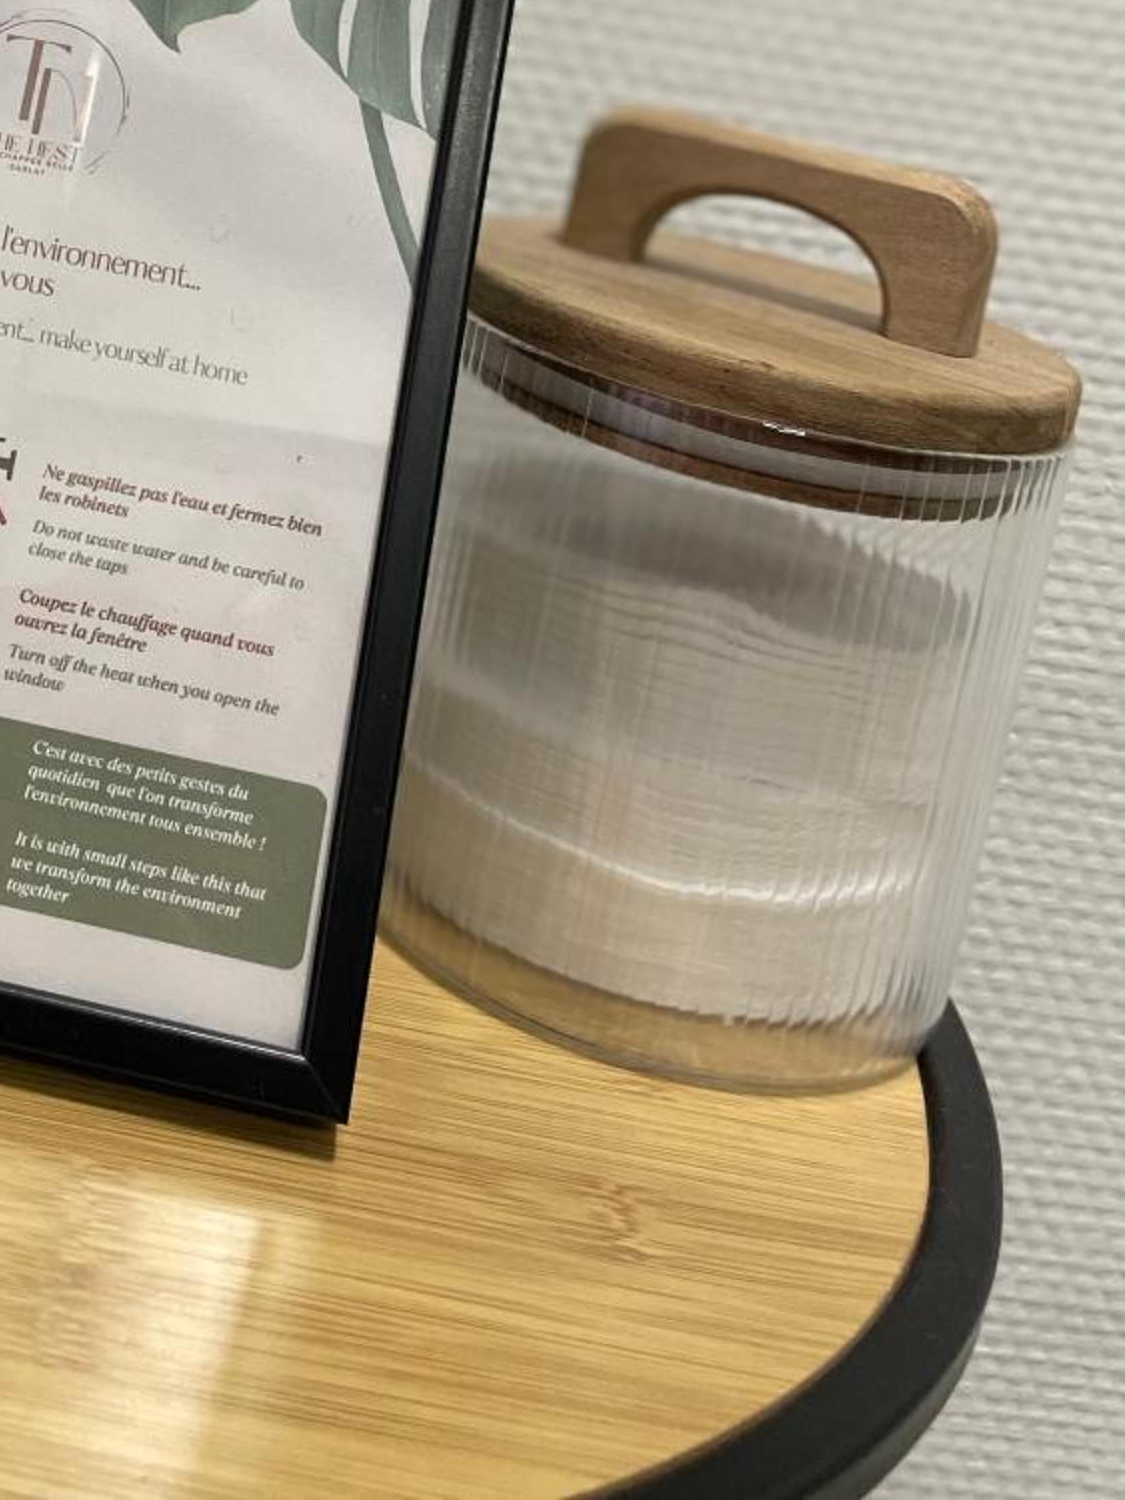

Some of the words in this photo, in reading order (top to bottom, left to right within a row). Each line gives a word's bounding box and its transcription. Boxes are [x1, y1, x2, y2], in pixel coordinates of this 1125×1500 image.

[0, 224, 201, 291] l'environnement...
[0, 269, 54, 296] vous
[38, 328, 92, 353] make
[92, 341, 170, 368] yourself
[167, 355, 188, 374] at
[192, 354, 248, 386] home
[38, 484, 61, 503] les
[63, 489, 129, 518] robinets
[42, 463, 65, 481] Ne
[64, 471, 137, 499] gaspillez
[137, 487, 168, 503] pas
[170, 490, 209, 511] l'eau
[211, 503, 228, 516] et
[225, 502, 285, 528] fermez
[286, 514, 322, 536] bien
[27, 541, 66, 561] close
[67, 550, 94, 567] the
[94, 557, 128, 575] taps
[31, 518, 55, 536] Do
[56, 527, 83, 542] not
[84, 533, 129, 552] waste
[131, 542, 176, 561] water
[177, 553, 210, 569] and
[210, 556, 230, 574] be
[231, 565, 287, 586] careful
[288, 576, 305, 590] to
[13, 613, 68, 635] ouvrez
[69, 622, 87, 640] la
[85, 626, 147, 652] fenêtre
[18, 587, 78, 614] Coupez
[79, 600, 95, 617] le
[97, 606, 178, 637] chauffage
[179, 626, 235, 648] quand
[236, 638, 275, 656] vous
[3, 668, 64, 691] window
[9, 643, 46, 665] Turn
[48, 653, 73, 672] off
[70, 655, 97, 676] the
[99, 662, 135, 684] heat
[136, 673, 179, 694] when
[178, 684, 210, 701] you
[212, 691, 251, 709] open
[253, 697, 280, 716] the
[27, 765, 100, 791] quotidien
[105, 783, 135, 798] que
[137, 786, 165, 805] l'on
[167, 795, 254, 825] transforme
[32, 740, 67, 760] C'est
[68, 751, 104, 768] avec
[105, 756, 132, 774] des
[133, 765, 176, 784] petits
[178, 775, 224, 795] gestes
[227, 783, 249, 800] du
[23, 783, 146, 824] l'environnement
[148, 814, 180, 832] tous
[183, 823, 256, 849] ensemble
[5, 878, 70, 902] together
[10, 856, 33, 871] we
[35, 861, 111, 889] transform
[114, 877, 140, 895] the
[141, 887, 241, 919] environment
[14, 830, 27, 846] It
[29, 834, 43, 850] is
[45, 840, 80, 859] with
[83, 849, 128, 869] small
[129, 860, 167, 879] steps
[170, 865, 199, 885] like
[201, 873, 231, 892] this
[233, 880, 266, 900] that
